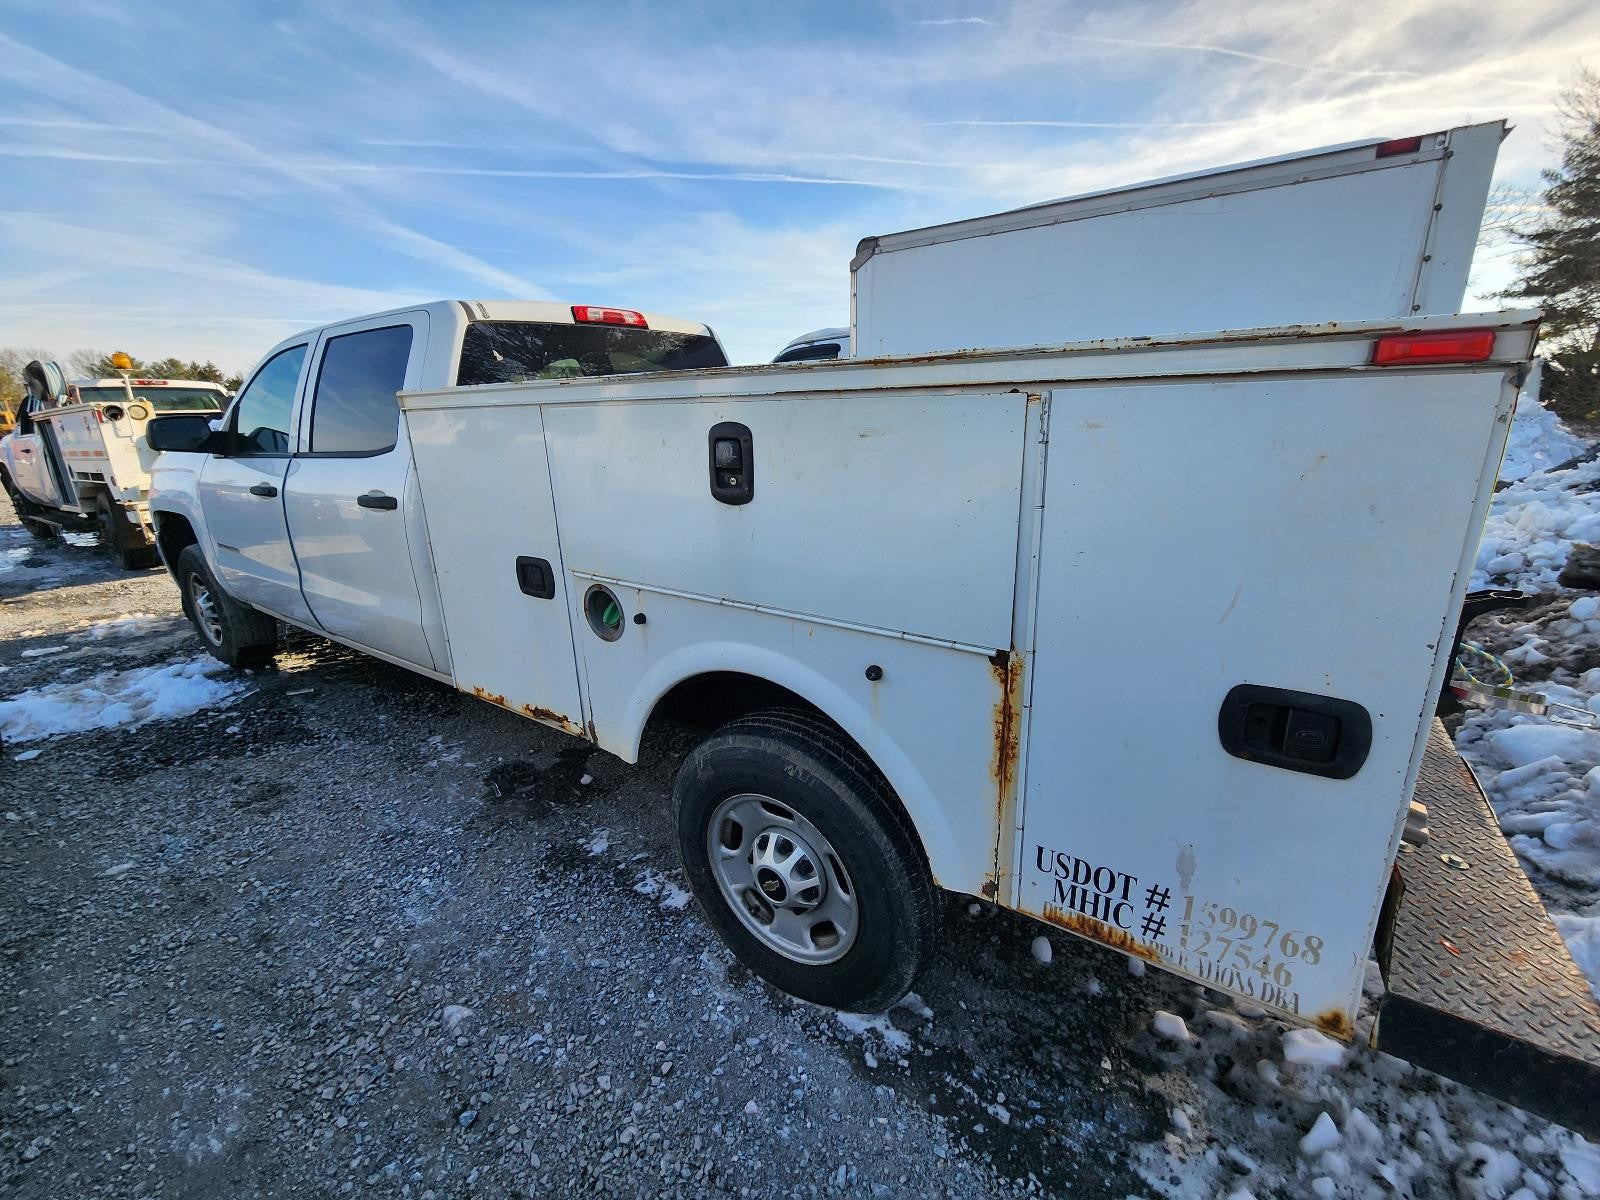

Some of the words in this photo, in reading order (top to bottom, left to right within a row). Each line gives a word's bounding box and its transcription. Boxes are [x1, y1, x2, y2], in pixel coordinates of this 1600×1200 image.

[1036, 845, 1138, 902] USDOT
[1144, 883, 1171, 912] #
[1181, 895, 1325, 966] 1599768
[1053, 878, 1134, 930] MHIC
[1140, 912, 1167, 940] #
[1178, 924, 1296, 988] 127546
